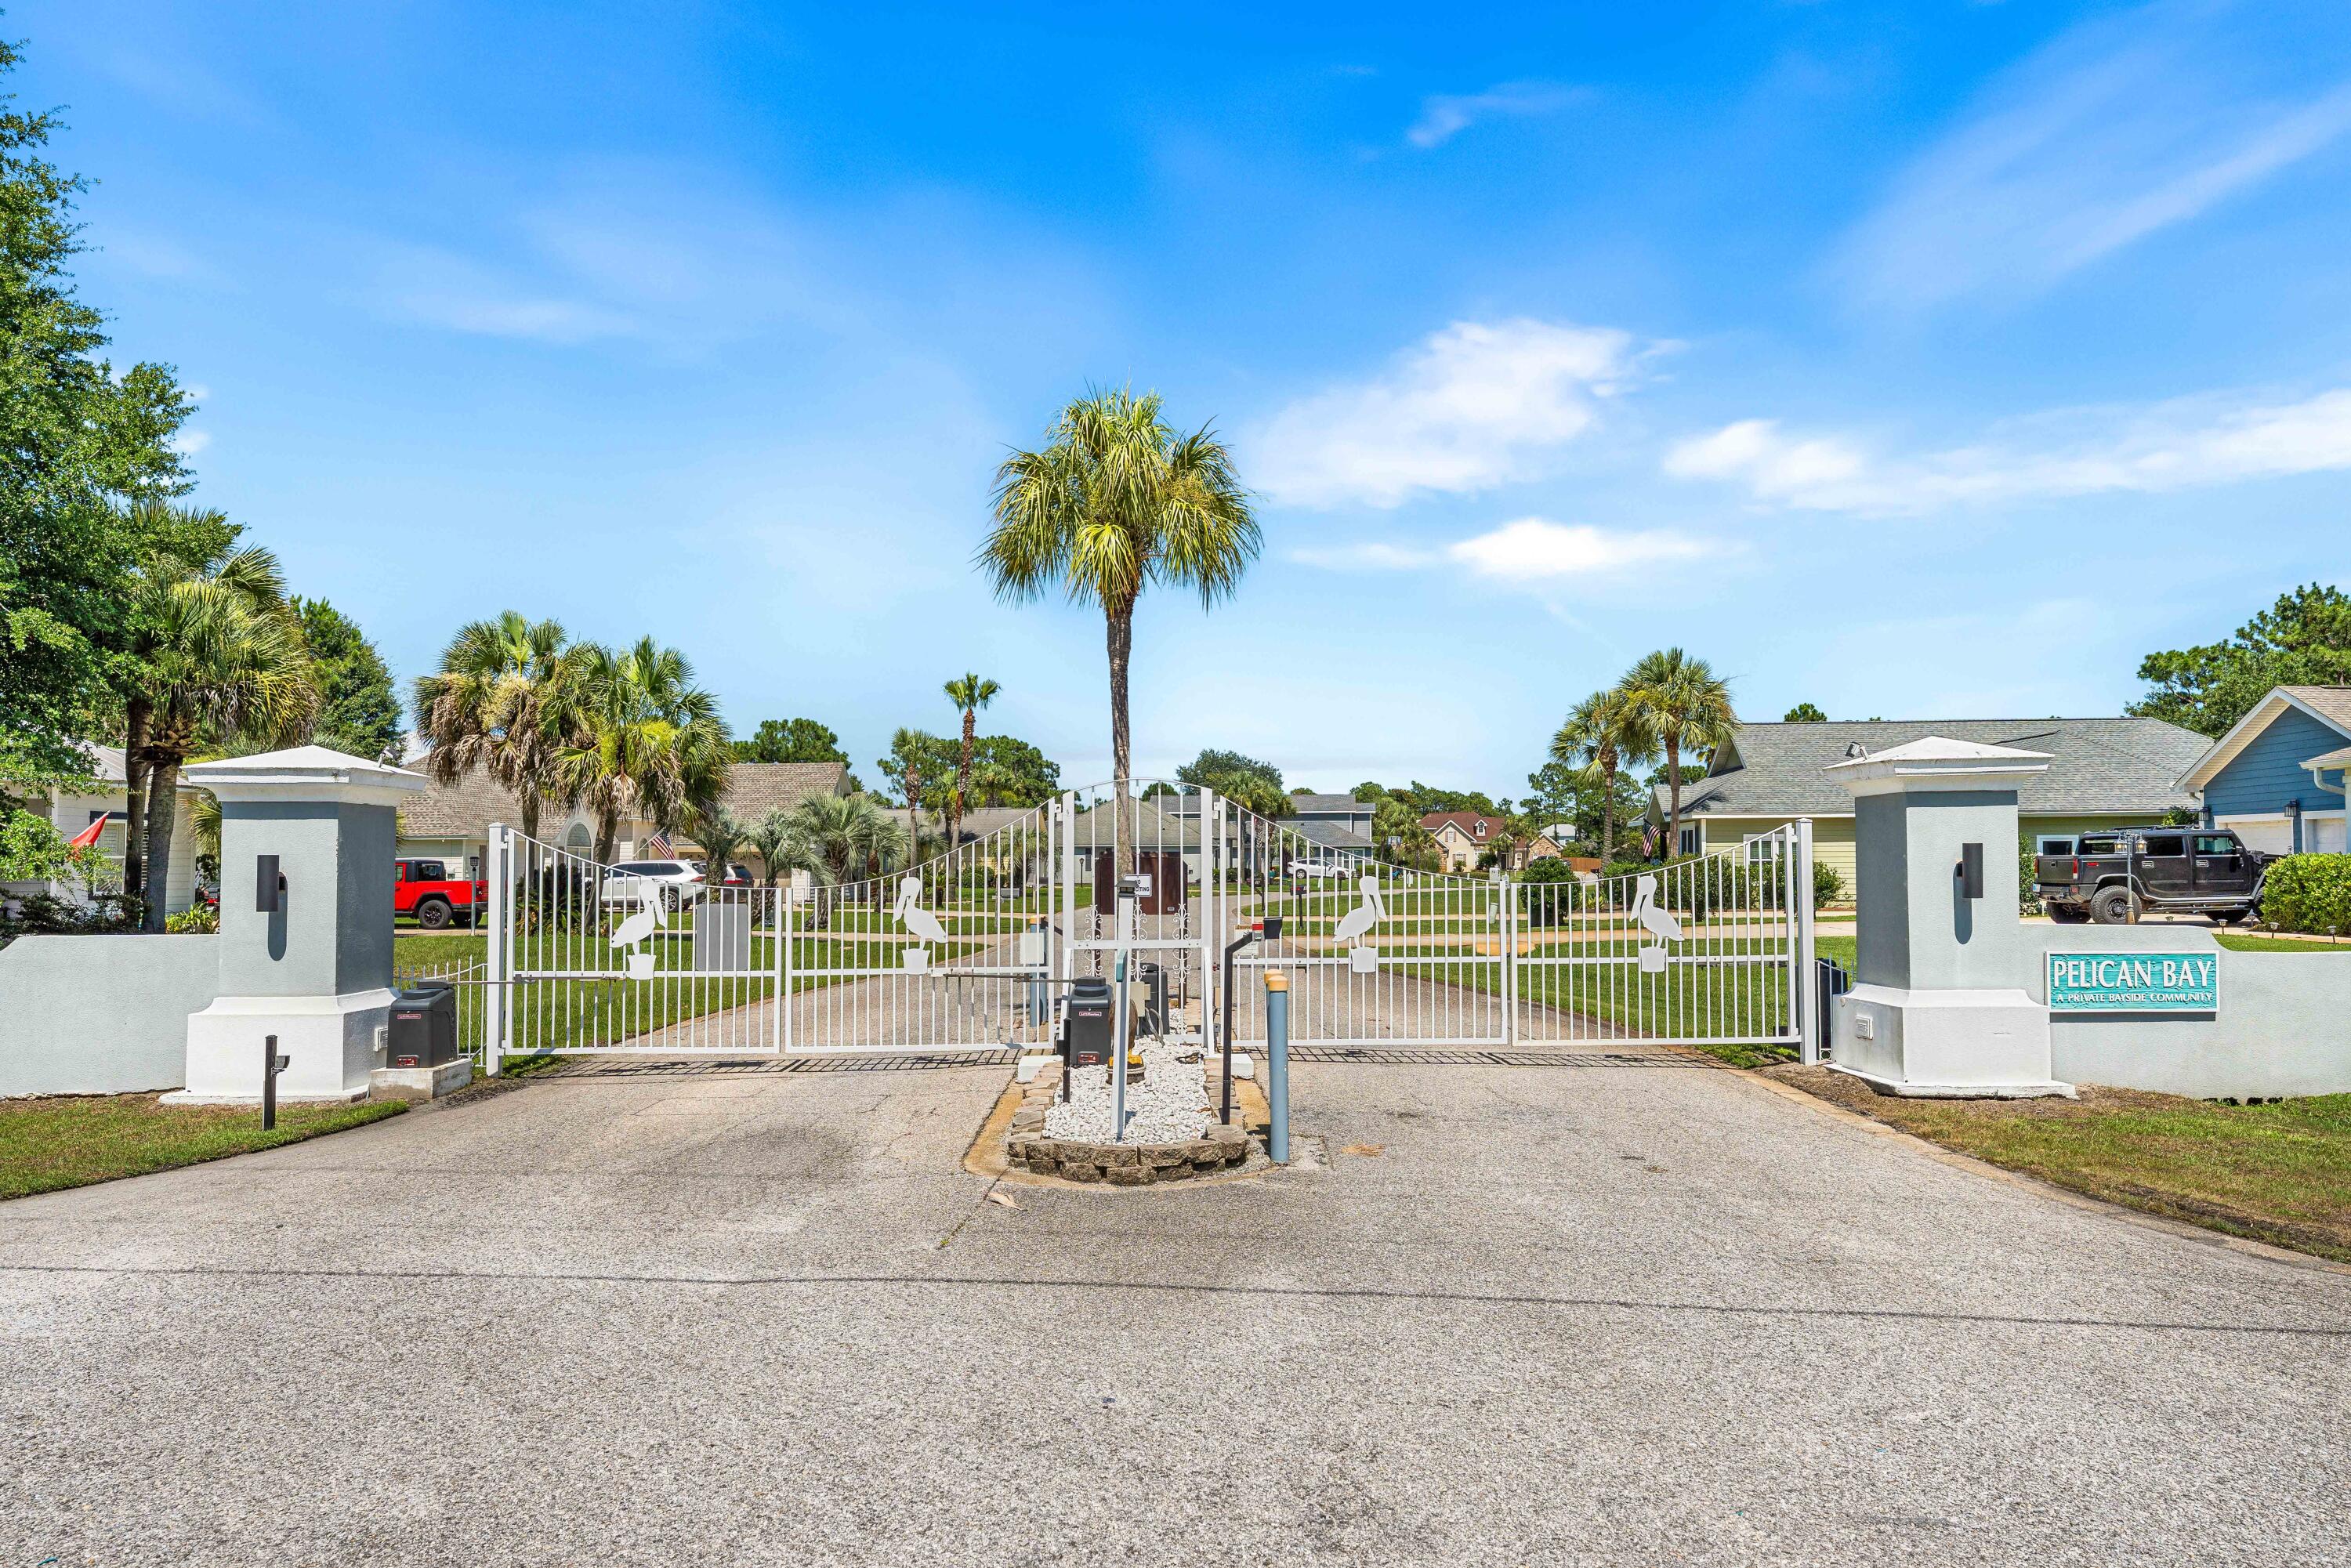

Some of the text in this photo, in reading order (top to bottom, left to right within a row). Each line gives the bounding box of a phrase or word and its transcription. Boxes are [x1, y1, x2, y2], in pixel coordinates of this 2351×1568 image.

[2054, 960, 2212, 987] PELICAN BAY
[2056, 993, 2213, 1002] A PRIVATE BAYSIDE COMMUNITY
